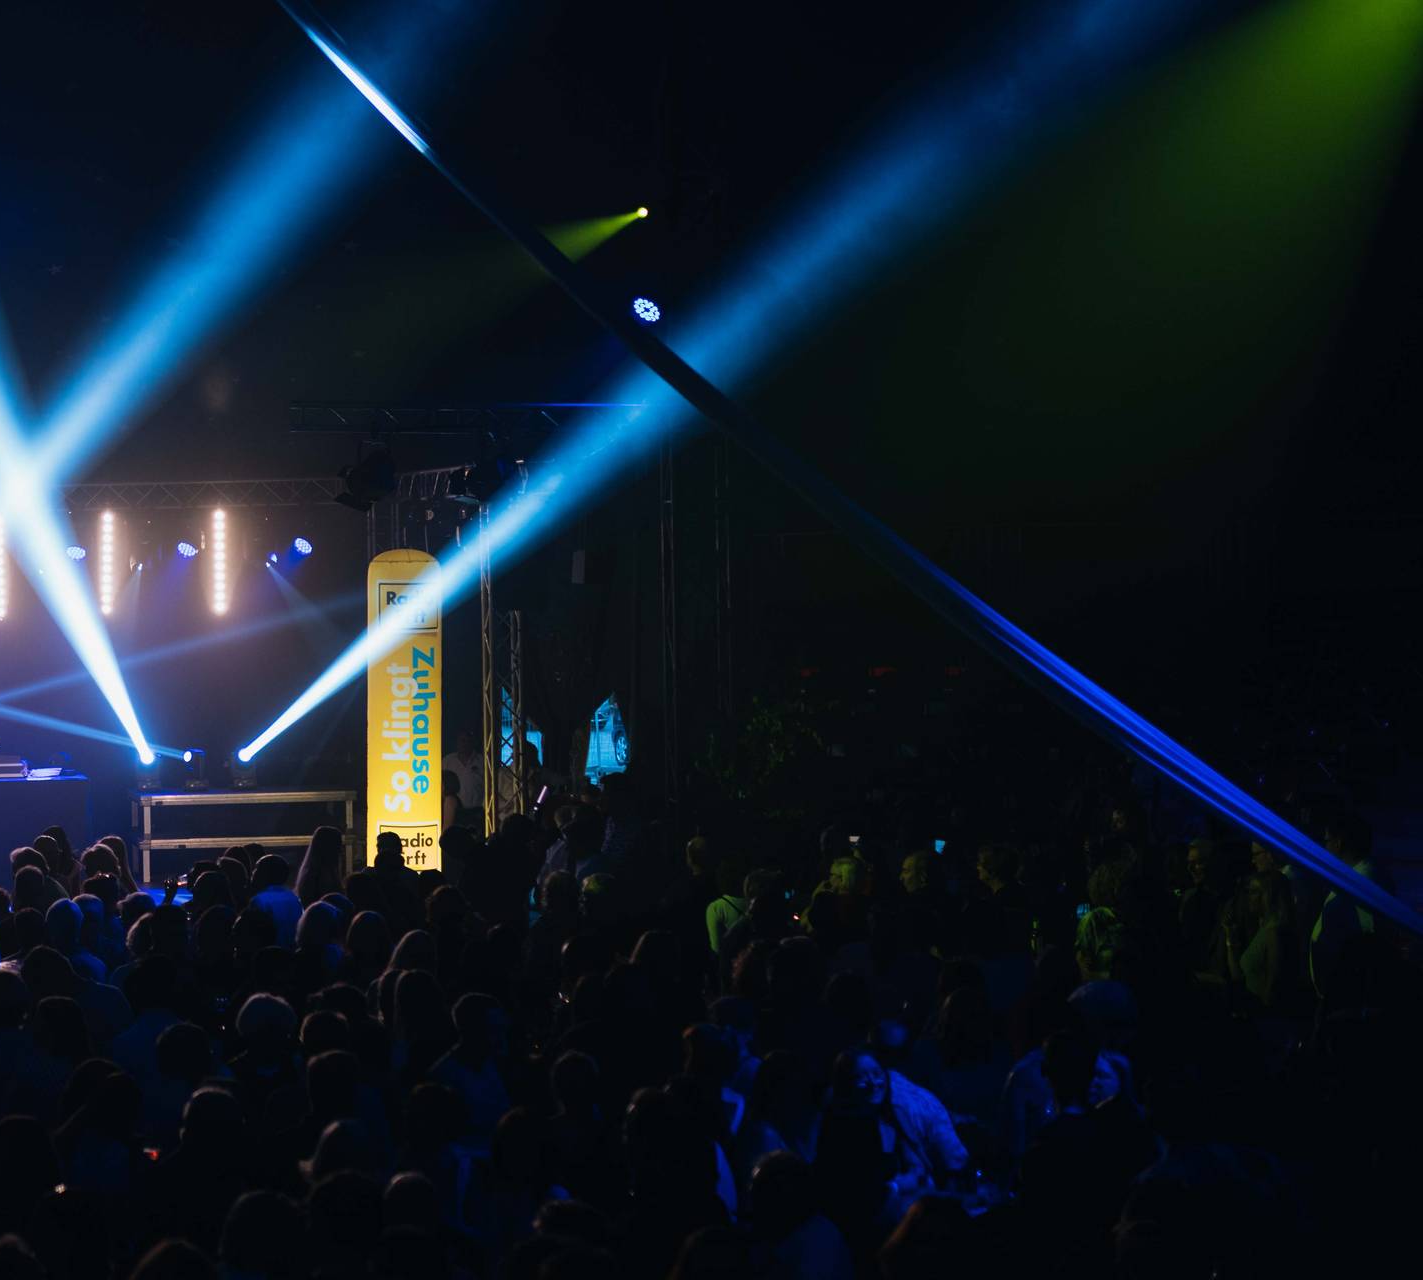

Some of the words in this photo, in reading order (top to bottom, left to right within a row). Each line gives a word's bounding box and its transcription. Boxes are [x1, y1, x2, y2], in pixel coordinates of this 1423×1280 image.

[382, 664, 418, 760] klingt
[412, 647, 436, 793] Zuhause
[385, 771, 410, 812] So
[400, 832, 434, 848] adio
[401, 850, 427, 866] rft
